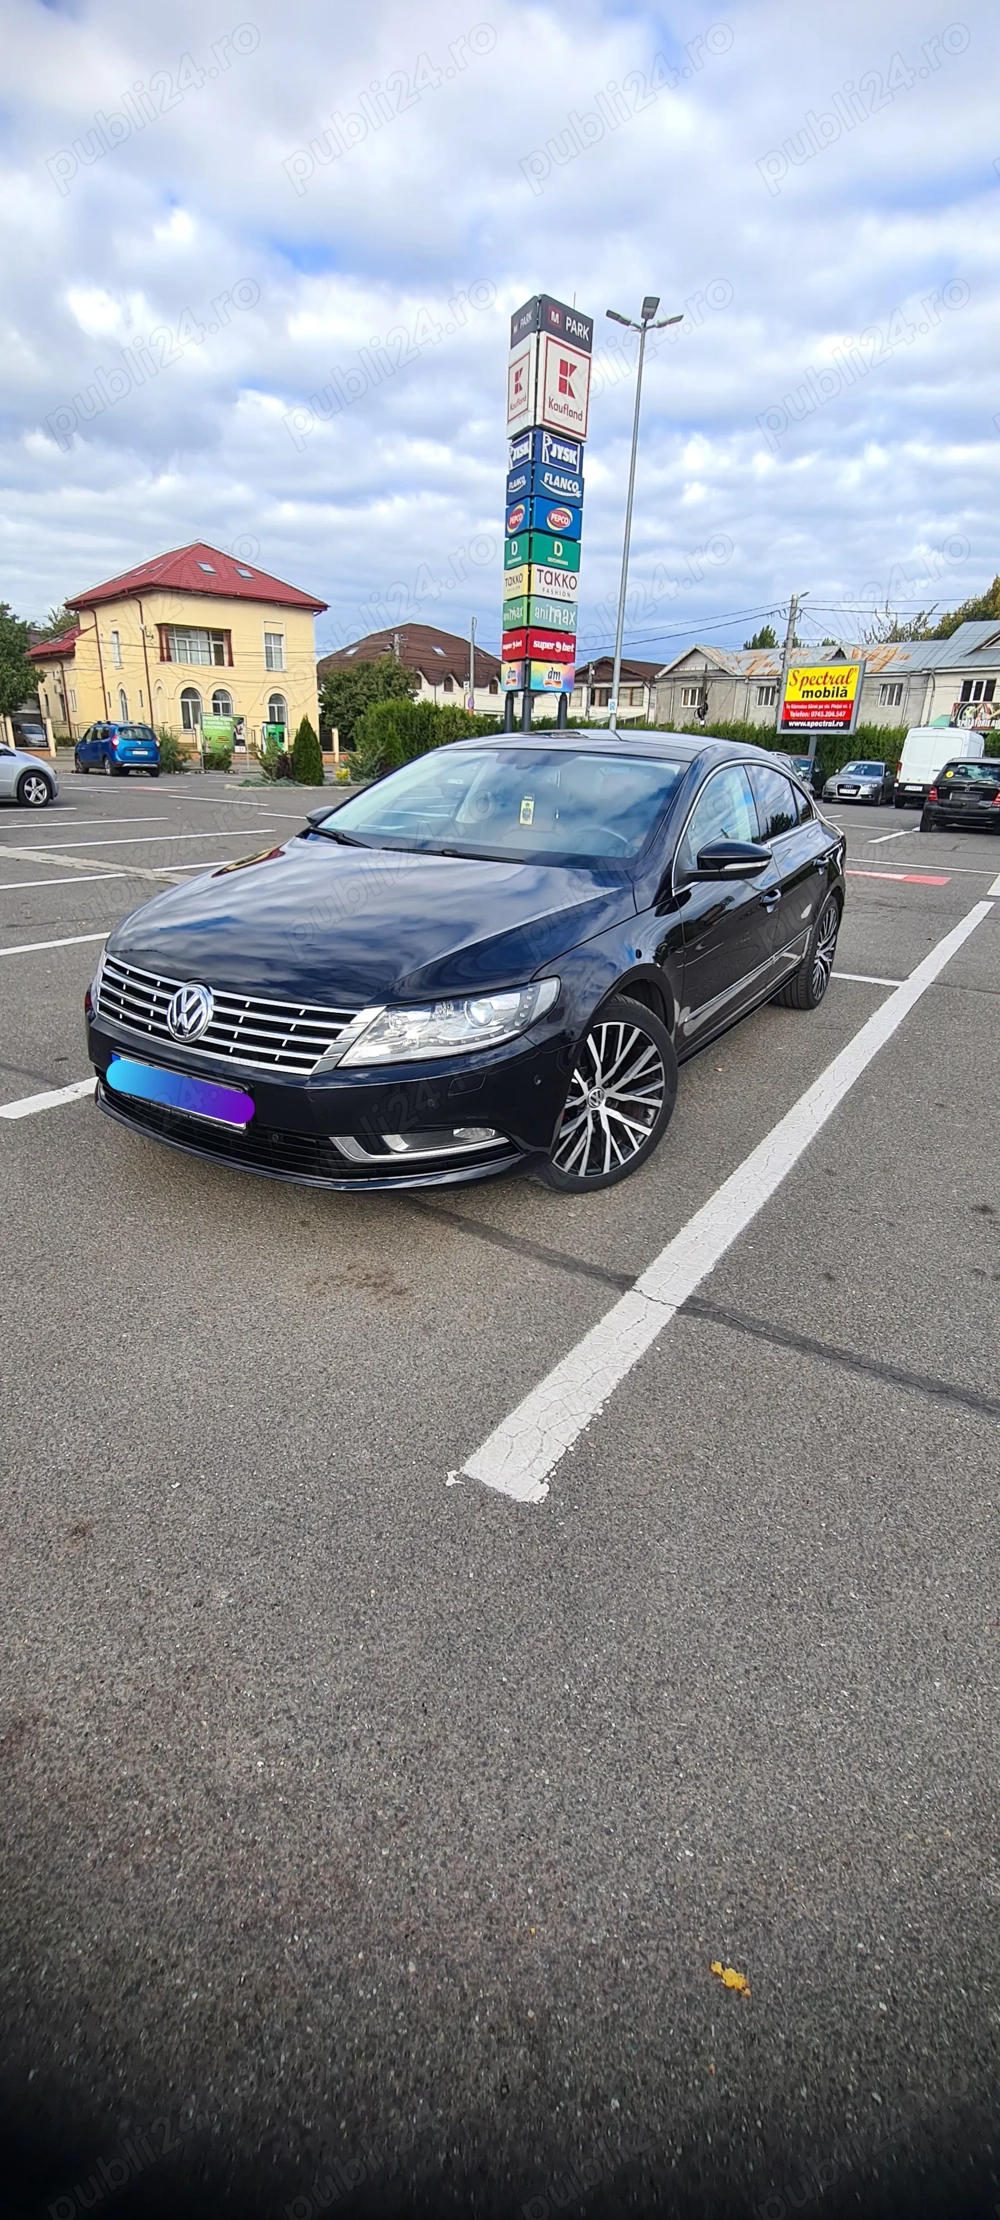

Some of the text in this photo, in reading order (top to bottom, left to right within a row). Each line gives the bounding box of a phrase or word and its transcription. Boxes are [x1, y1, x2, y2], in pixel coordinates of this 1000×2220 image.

[551, 310, 590, 341] M PARK
[548, 396, 583, 421] Kaufland
[550, 443, 577, 465] JYSK
[544, 472, 579, 492] FLANCO
[550, 512, 570, 525] PEPCO
[511, 541, 518, 556] D
[554, 541, 563, 557] D
[543, 587, 571, 598] FASHION
[548, 667, 561, 680] dm
[789, 667, 853, 691] Spectral
[801, 686, 848, 698] mobilă
[789, 720, 844, 728] www.spectral.ro
